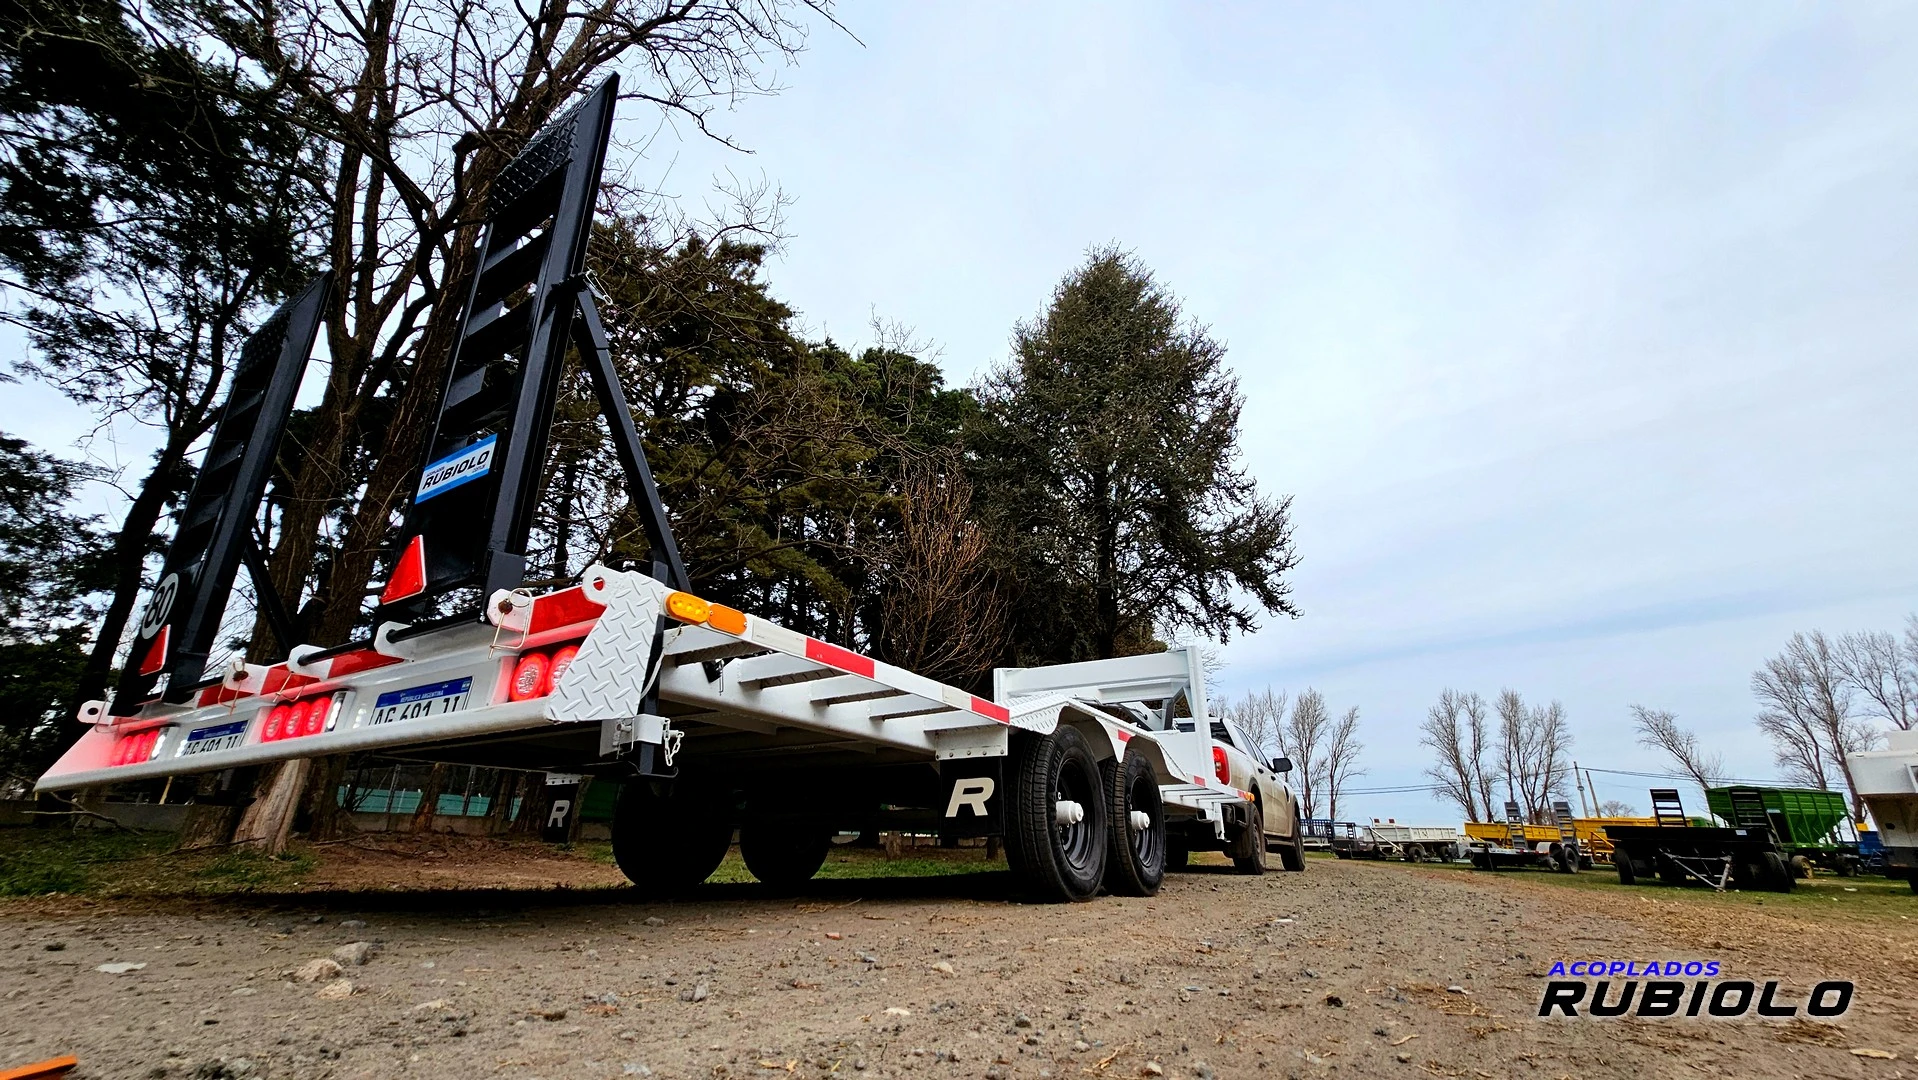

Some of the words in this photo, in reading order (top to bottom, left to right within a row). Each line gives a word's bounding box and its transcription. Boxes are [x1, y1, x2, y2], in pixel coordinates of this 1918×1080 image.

[422, 450, 490, 490] RUBIOLO
[144, 582, 176, 629] 80
[547, 799, 570, 828] R
[945, 776, 995, 818] R
